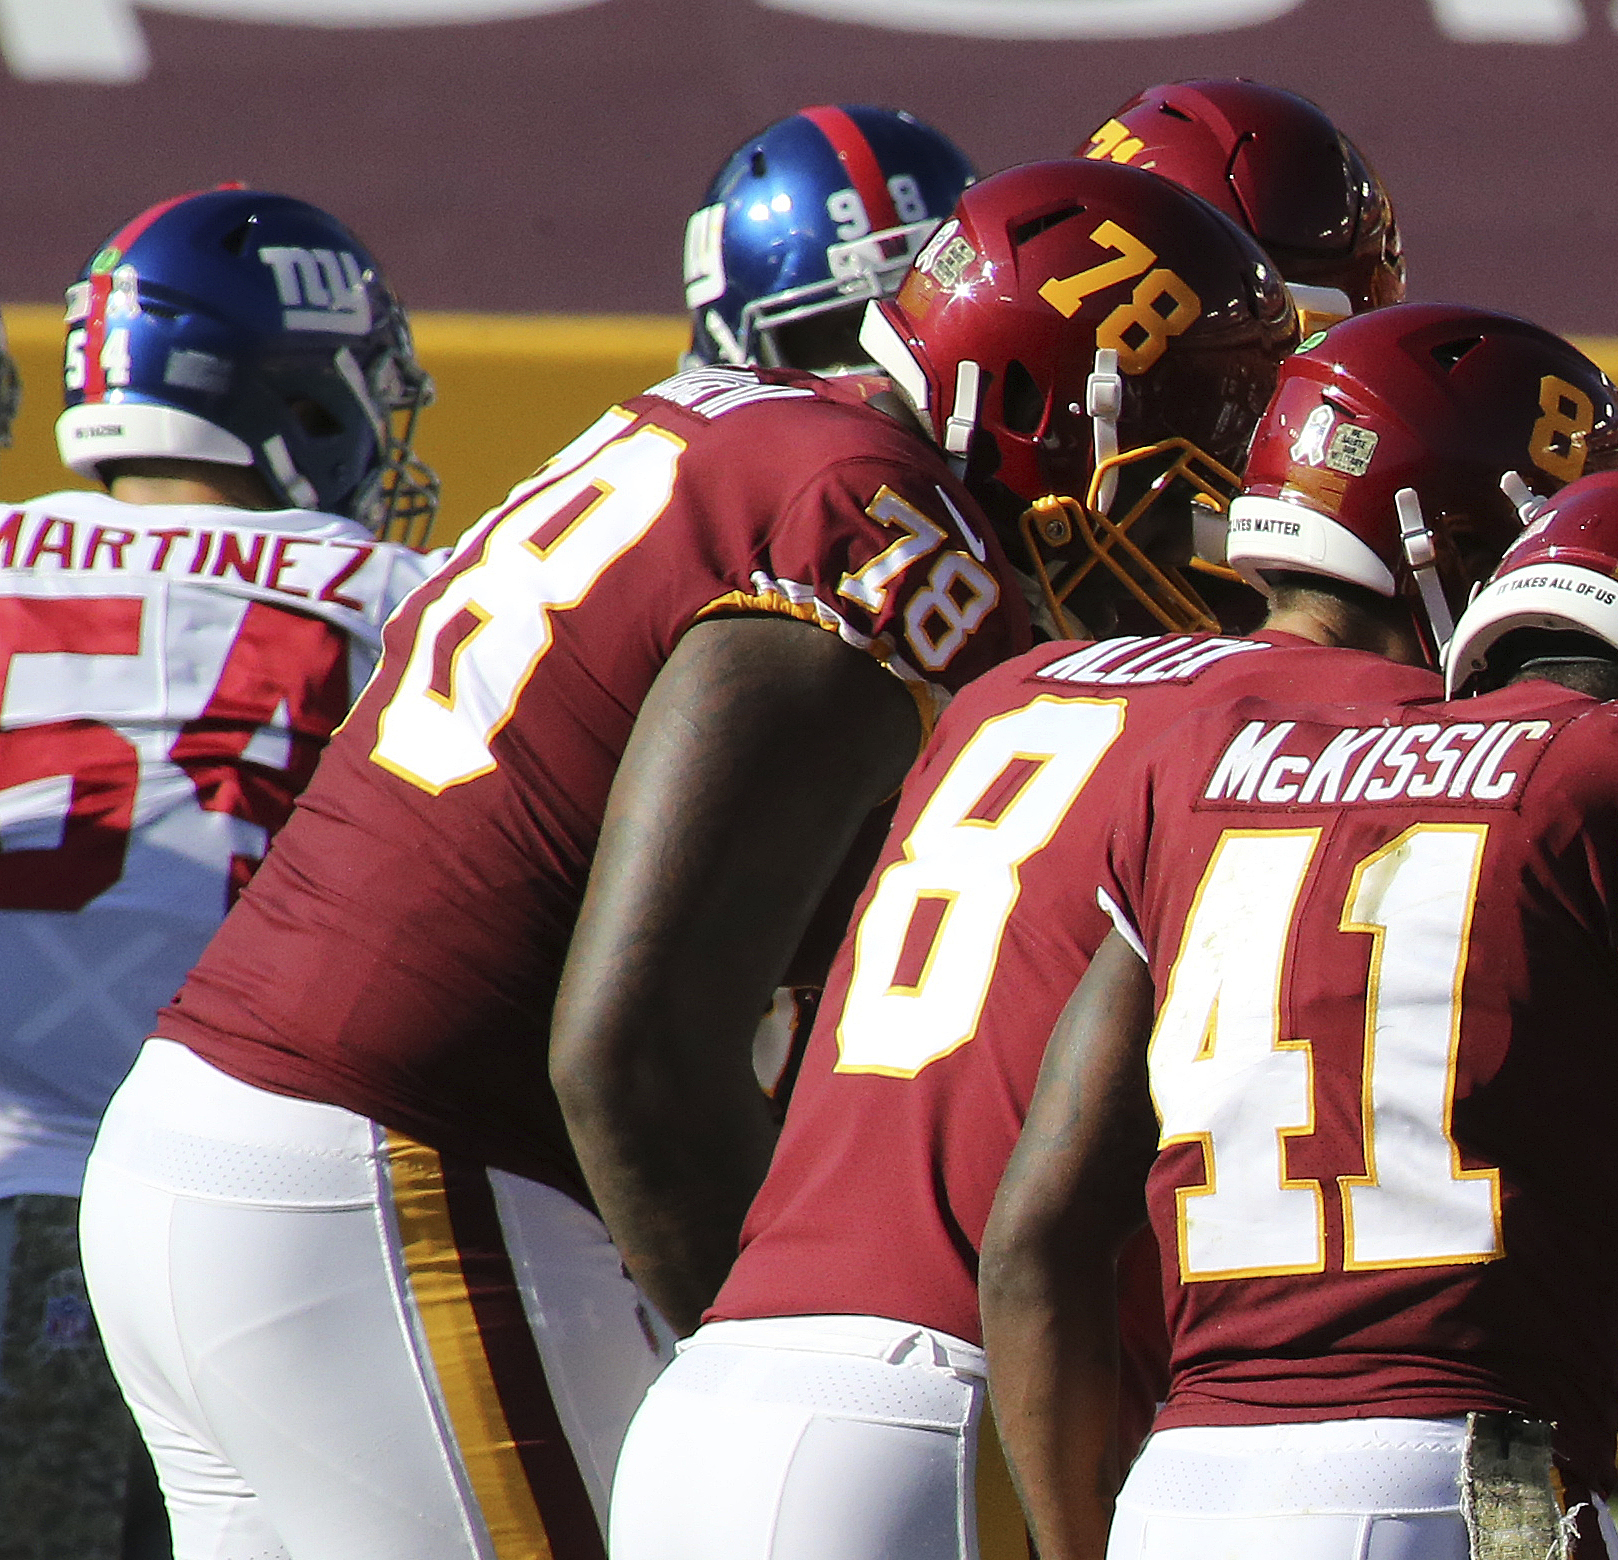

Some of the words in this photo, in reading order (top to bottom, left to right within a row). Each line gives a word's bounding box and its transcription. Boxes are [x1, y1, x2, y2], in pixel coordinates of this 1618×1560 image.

[1038, 219, 1201, 376] 78
[1528, 375, 1595, 482] 8
[837, 484, 1000, 673] 78
[1253, 519, 1301, 536] MATTER
[1496, 582, 1507, 596] IT
[1510, 577, 1548, 591] TAKES
[1549, 577, 1573, 591] ALL
[1576, 582, 1595, 597] OF
[1595, 588, 1616, 605] US
[1035, 635, 1273, 684] ALLEN
[1204, 719, 1552, 805] McKISSIC
[834, 692, 1128, 1081] 8
[1148, 821, 1506, 1285] 41
